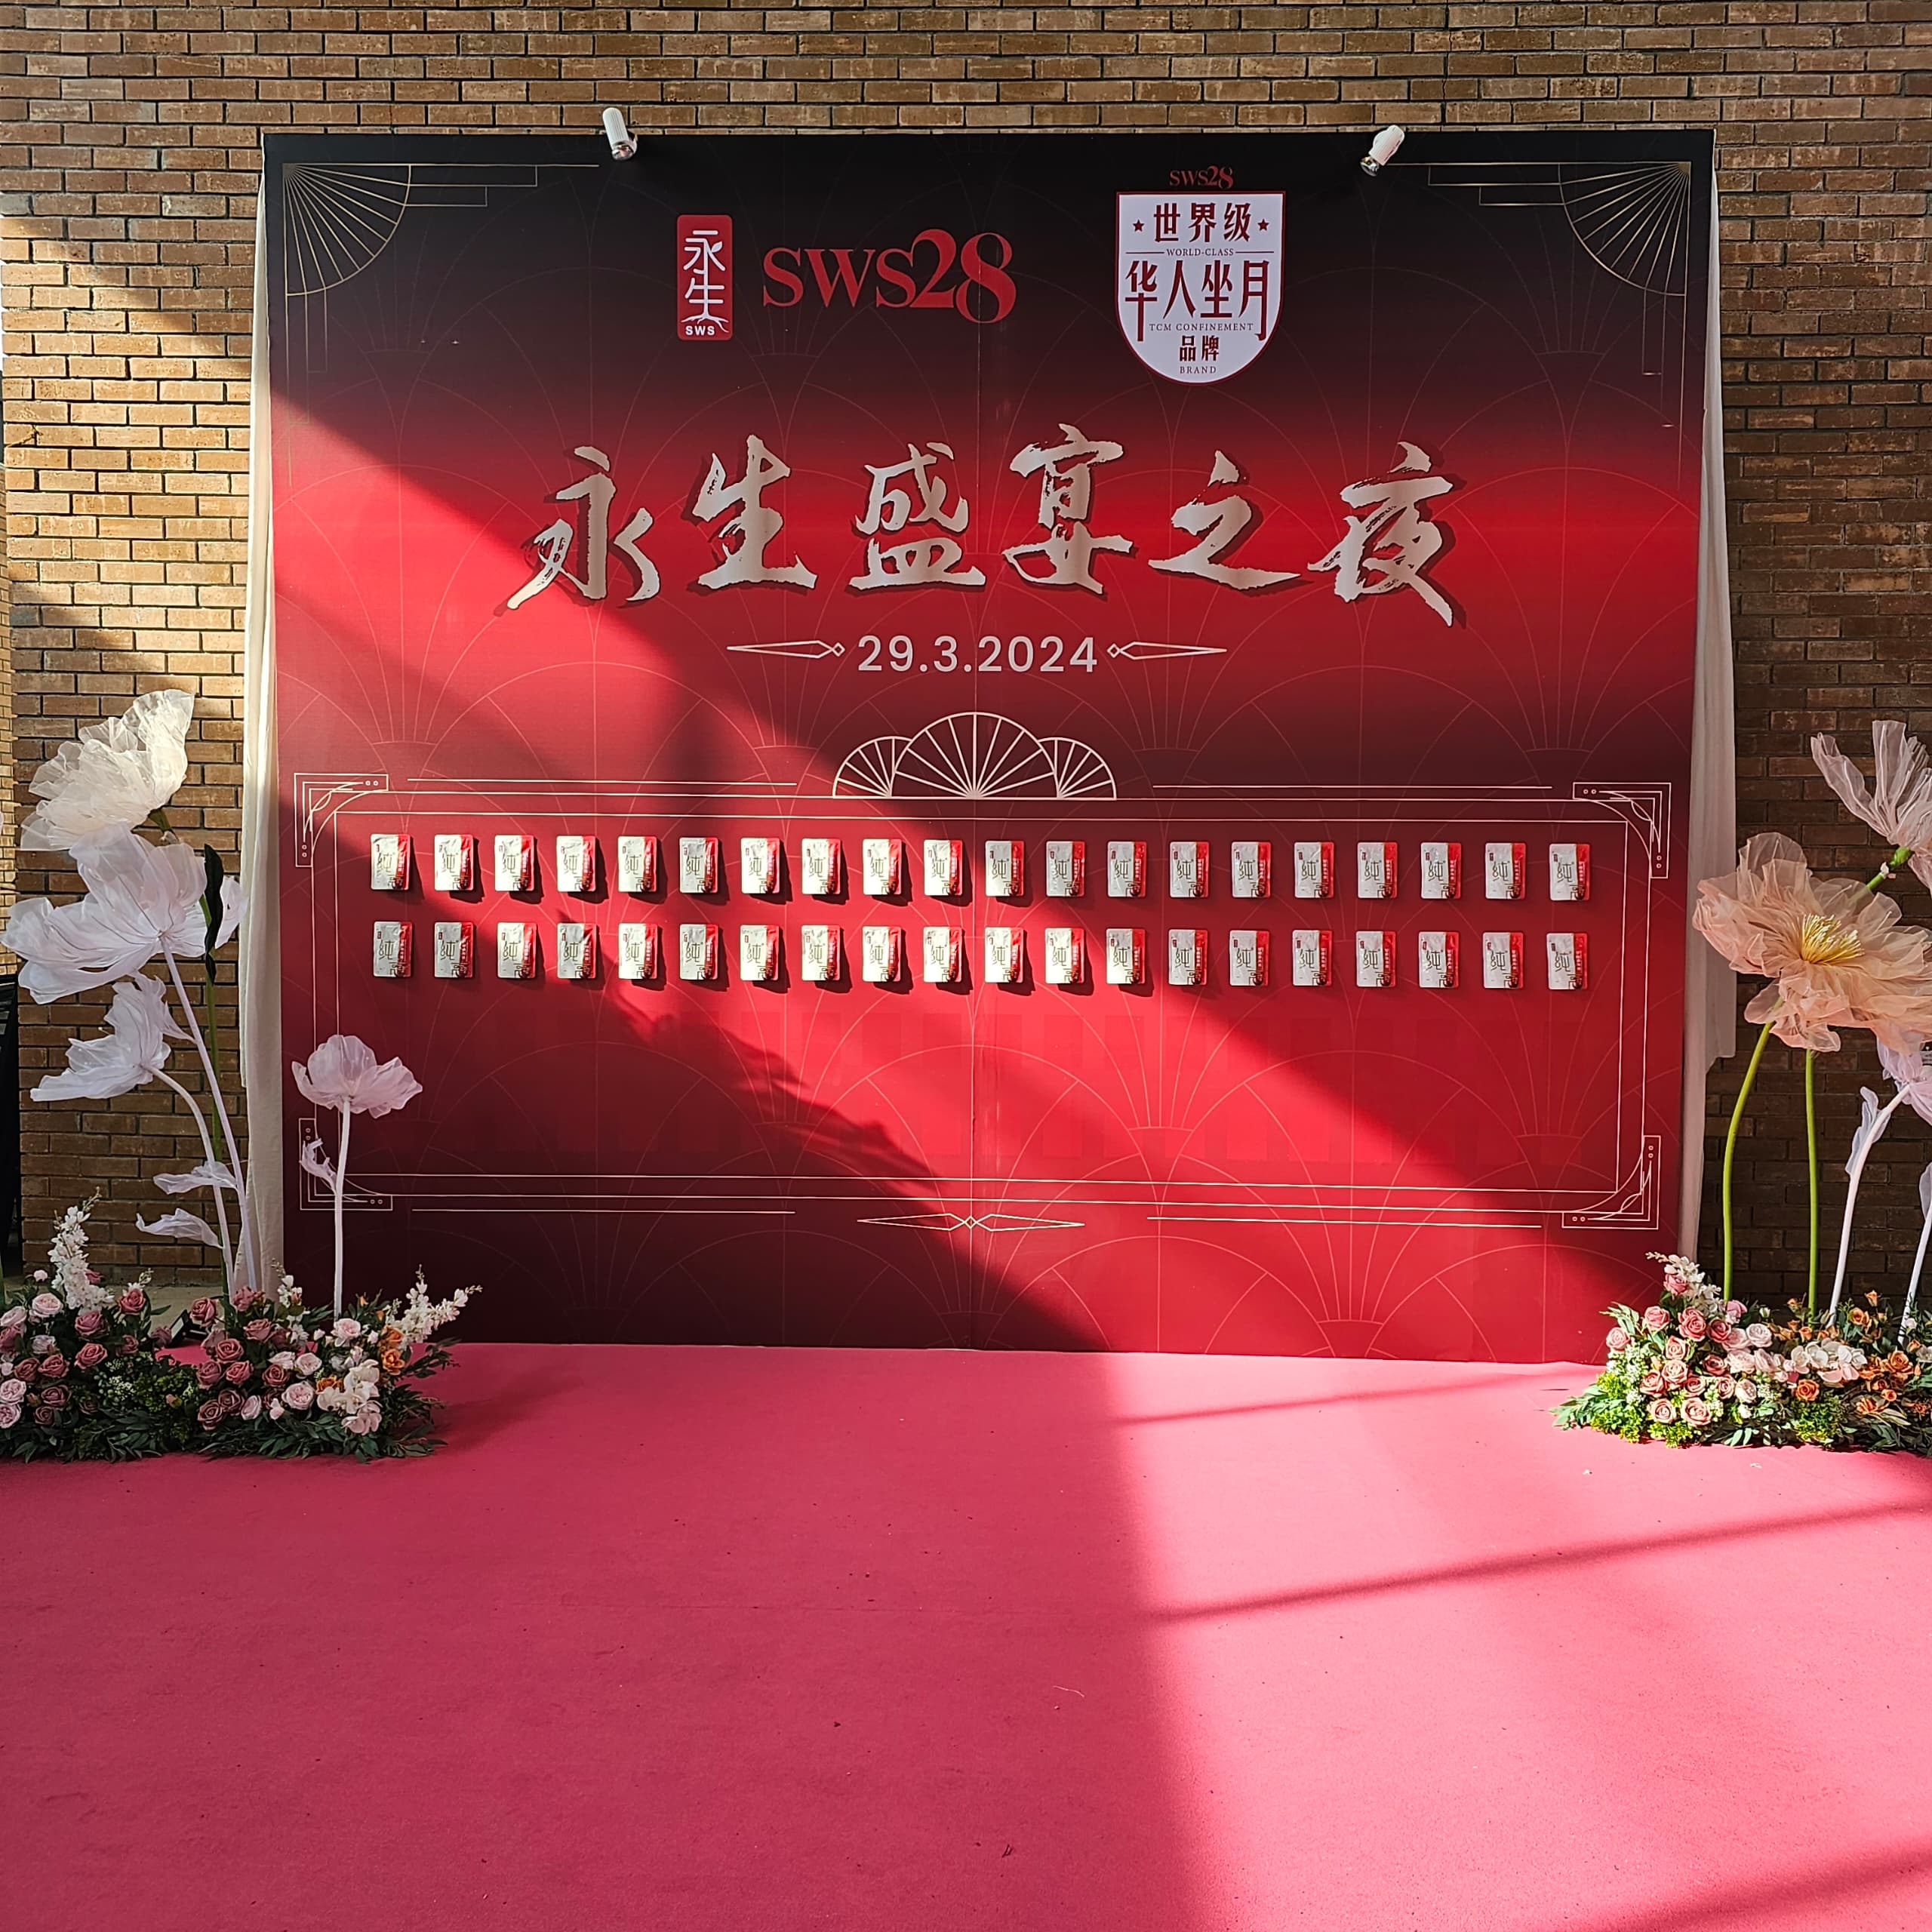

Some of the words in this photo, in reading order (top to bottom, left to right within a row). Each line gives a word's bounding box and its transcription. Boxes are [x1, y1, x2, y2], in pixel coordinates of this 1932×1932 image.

[1169, 165, 1234, 189] SWS28
[1154, 202, 1251, 243] 世界级
[1166, 248, 1235, 257] WORLD-CLASS
[682, 229, 729, 333] 永生
[763, 229, 1017, 323] SWS28
[1124, 260, 1269, 342] 华人坐月
[685, 325, 715, 336] SWS
[1149, 323, 1172, 331] TCM
[1176, 322, 1254, 332] CONFINEMENT
[1180, 335, 1220, 362] 品牌
[1180, 366, 1217, 374] BRAND
[506, 423, 1457, 627] 永生盛宴之夜
[857, 635, 1097, 672] 29.3.2024
